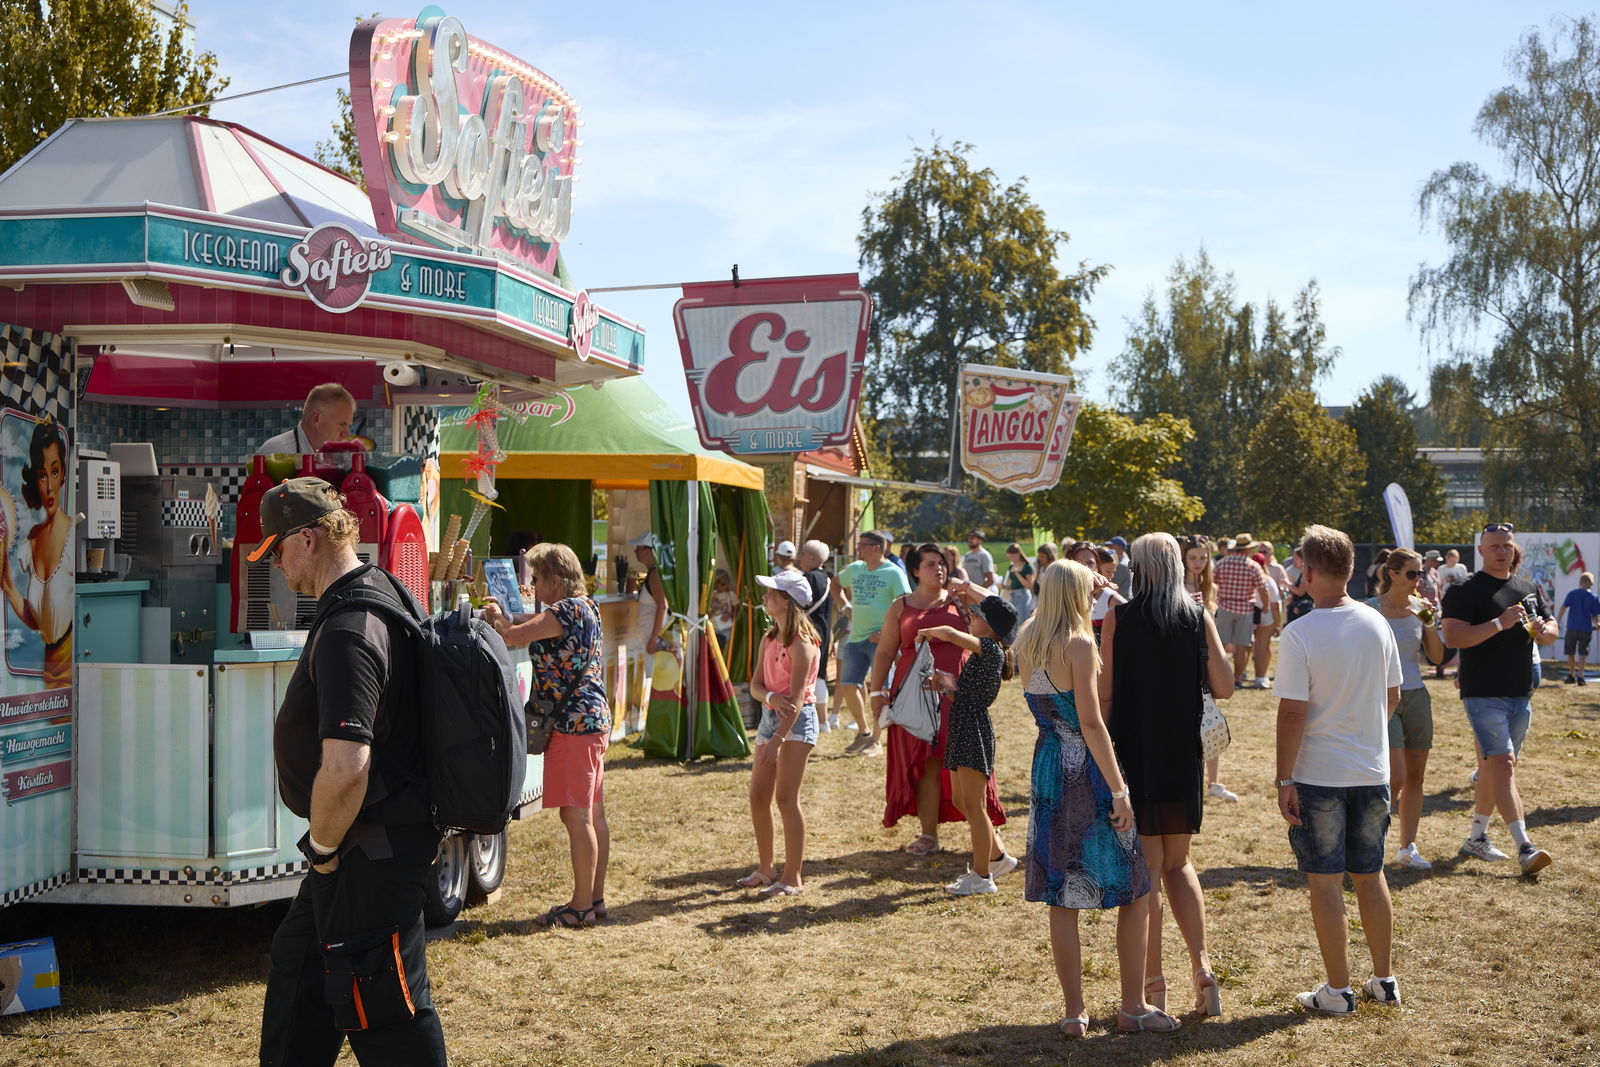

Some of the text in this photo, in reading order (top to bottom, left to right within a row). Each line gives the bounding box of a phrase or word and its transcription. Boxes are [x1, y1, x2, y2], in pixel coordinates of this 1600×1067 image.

[393, 16, 572, 250] Softeis
[183, 229, 467, 300] ICECREAM Softeis & MORE
[532, 293, 565, 332] ICECREAM
[569, 301, 599, 344] Softeis
[705, 312, 848, 417] Eis
[750, 430, 803, 449] & MORE
[968, 408, 1049, 454] LANGOS
[0, 694, 69, 718] Unwiderstehlich
[6, 731, 65, 755] Hausgemacht
[17, 769, 54, 791] Köstlich
